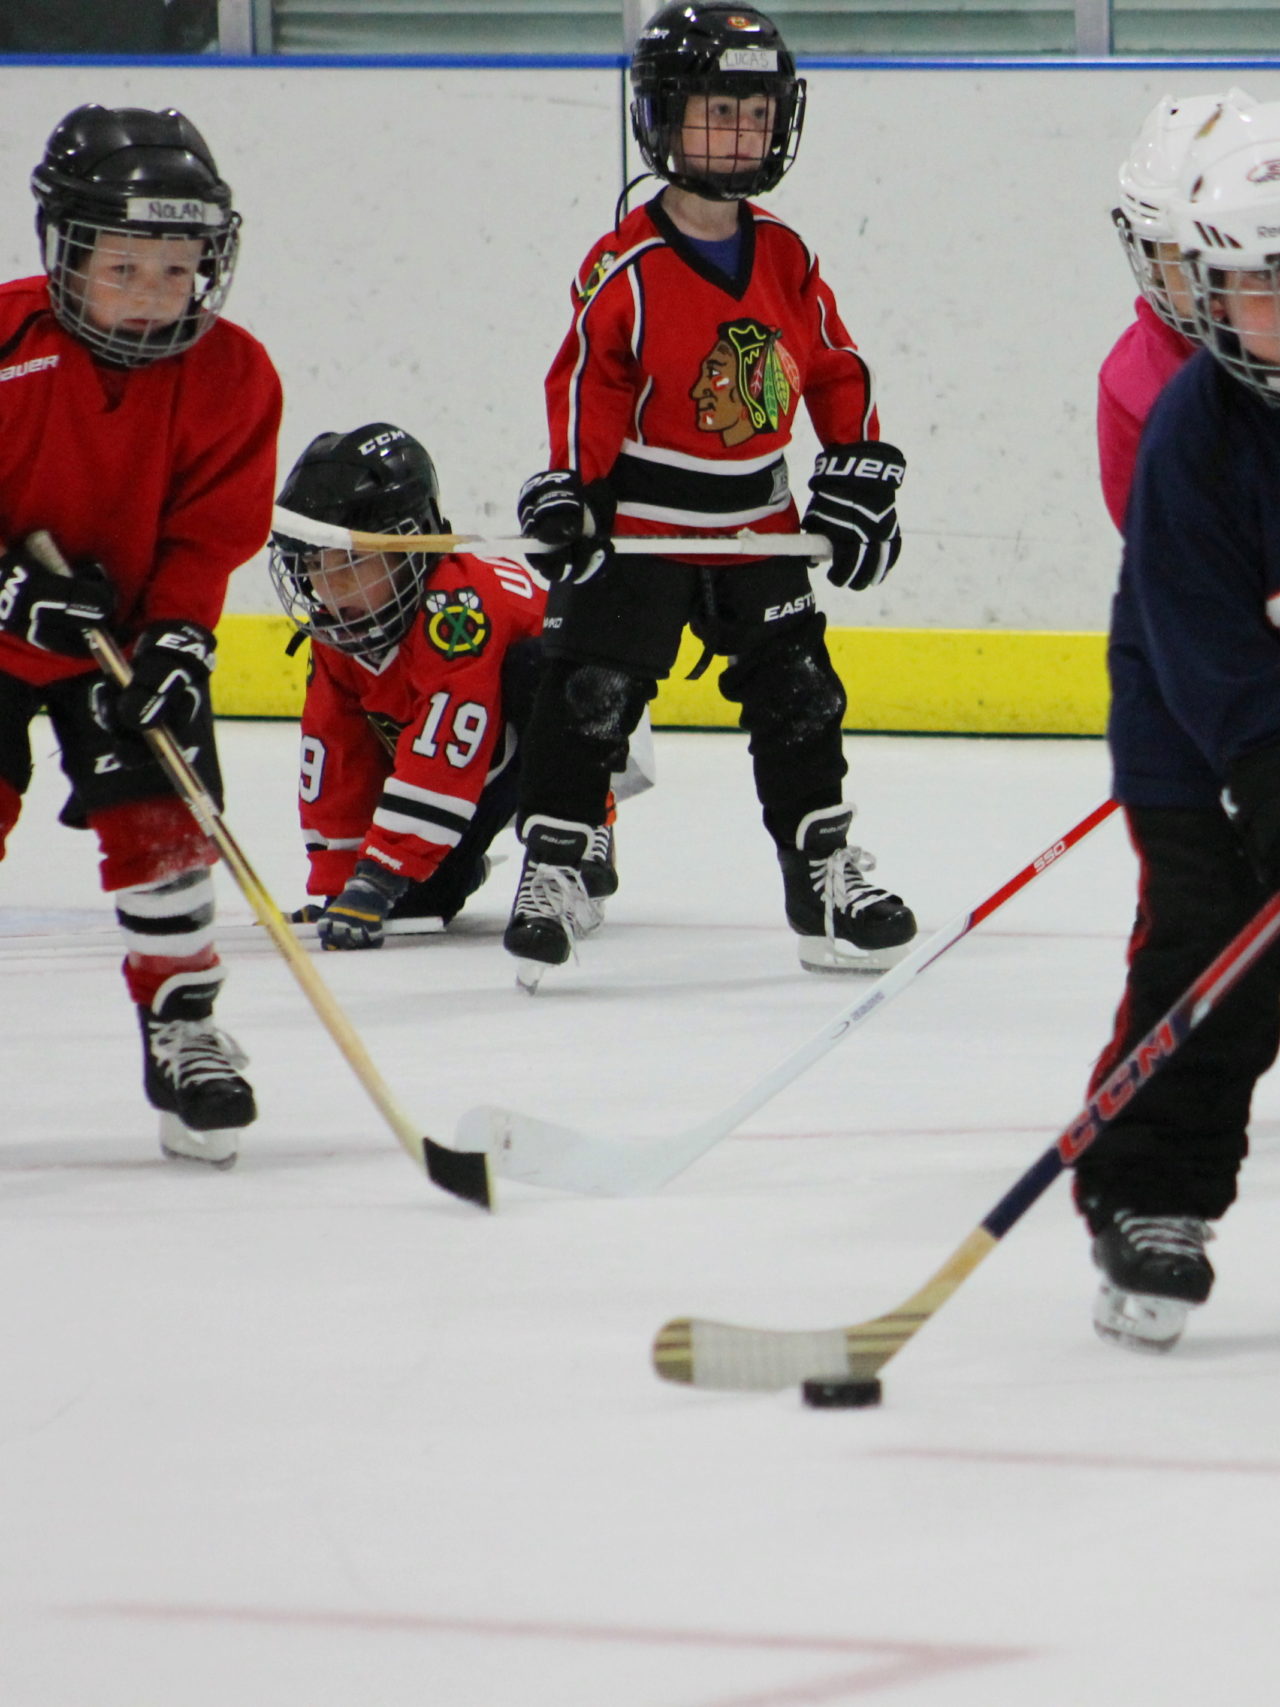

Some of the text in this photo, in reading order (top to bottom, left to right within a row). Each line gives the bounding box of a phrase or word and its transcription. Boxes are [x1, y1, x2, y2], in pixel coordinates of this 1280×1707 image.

[725, 51, 770, 68] LUCAS
[148, 202, 204, 221] NOLAN
[0, 355, 61, 382] AUER
[357, 429, 406, 456] CCM
[813, 456, 905, 485] AUER
[763, 592, 816, 622] EAST
[412, 691, 488, 769] 19
[299, 734, 327, 805] 9
[1056, 1018, 1178, 1166] CCM
